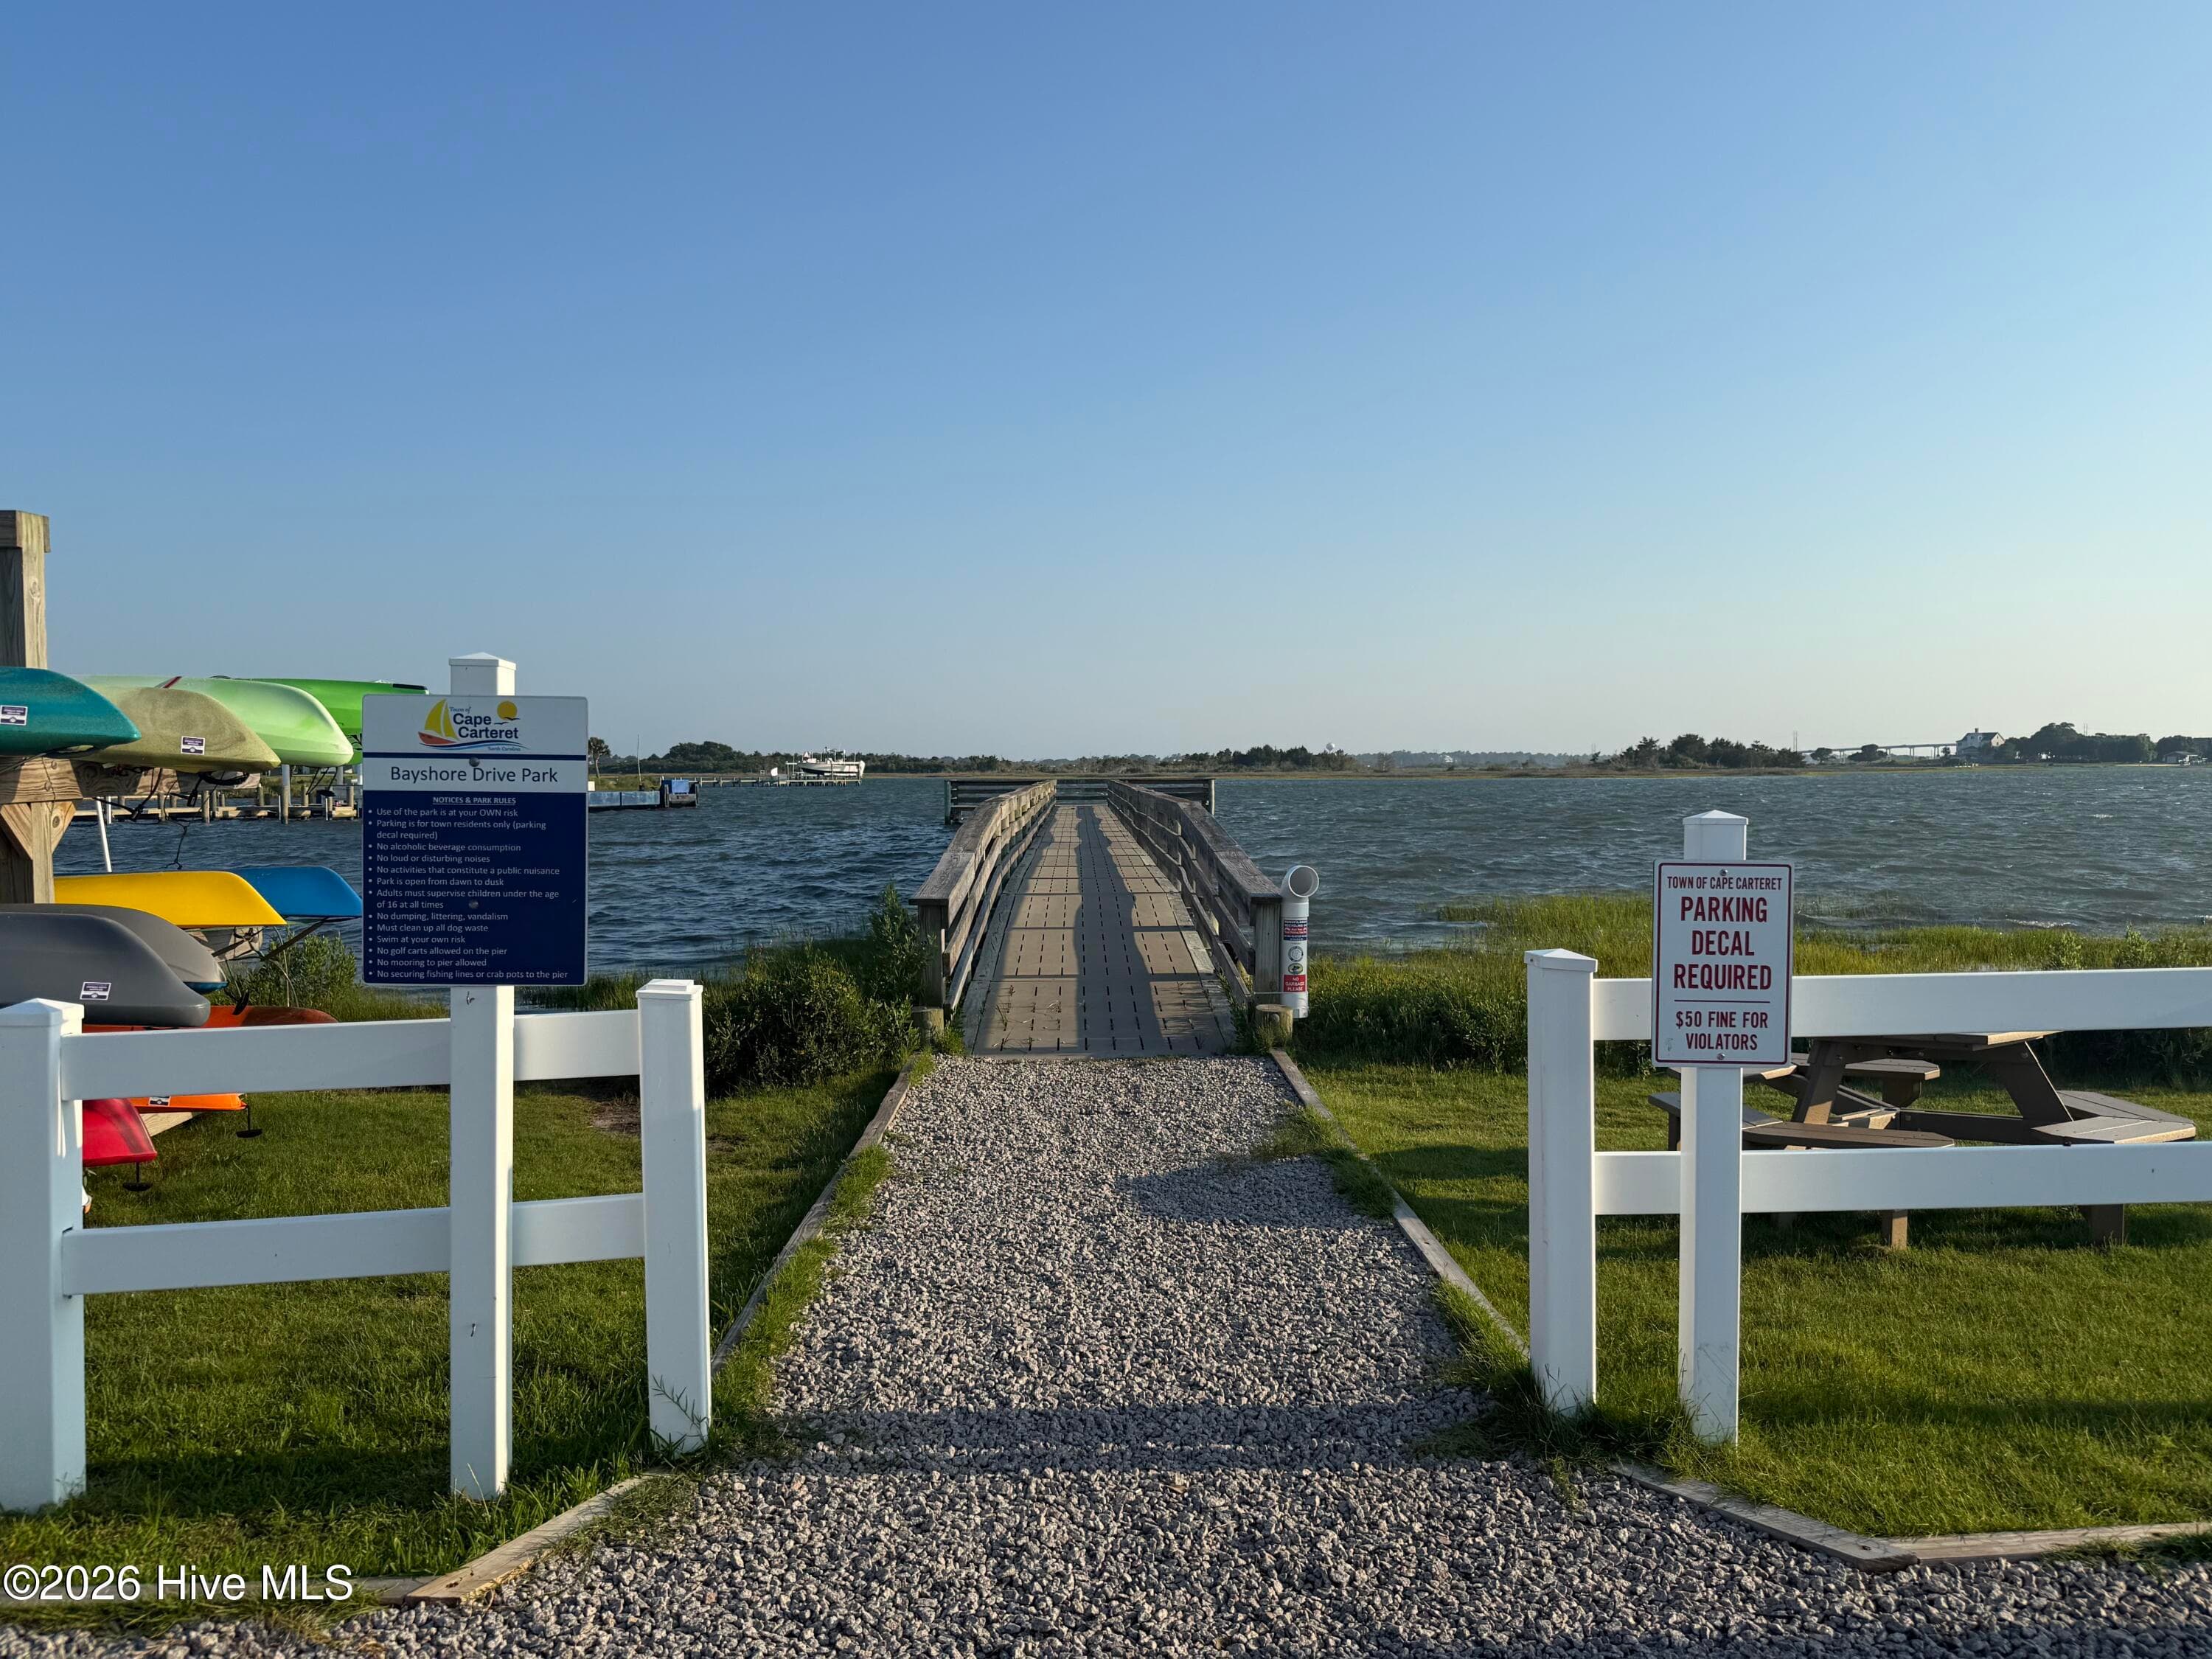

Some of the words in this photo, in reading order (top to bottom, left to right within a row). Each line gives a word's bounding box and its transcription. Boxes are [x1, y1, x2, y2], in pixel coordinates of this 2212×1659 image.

[453, 714, 491, 727] Cape
[459, 727, 518, 738] Carteret
[392, 767, 467, 784] Bayshore
[473, 768, 515, 782] Drive
[523, 768, 557, 782] Park
[378, 820, 406, 828] Parking
[493, 821, 510, 829] only
[513, 821, 546, 830] (parking
[400, 832, 437, 840] required)
[429, 844, 465, 852] beverage
[422, 855, 462, 863] disturbing
[497, 867, 521, 875] public
[1667, 877, 1693, 888] TOWN
[1697, 877, 1708, 888] OF
[1710, 877, 1733, 889] CAPE
[1736, 877, 1781, 890] CARTERET
[427, 890, 465, 898] supervise
[1681, 897, 1767, 922] PARKING
[391, 912, 428, 921] dumping,
[431, 913, 465, 921] littering,
[448, 925, 462, 933] dog
[1692, 931, 1754, 956] DECAL
[391, 947, 406, 956] golf
[392, 959, 425, 967] mooring
[438, 959, 453, 967] pier
[391, 970, 425, 978] securing
[427, 970, 453, 978] fishing
[553, 971, 568, 979] pier
[1674, 964, 1771, 990] REQUIRED
[1676, 1011, 1702, 1029] $50
[1708, 1012, 1736, 1027] FINE
[1743, 1012, 1767, 1028] FOR
[1686, 1033, 1757, 1050] VIOLATORS
